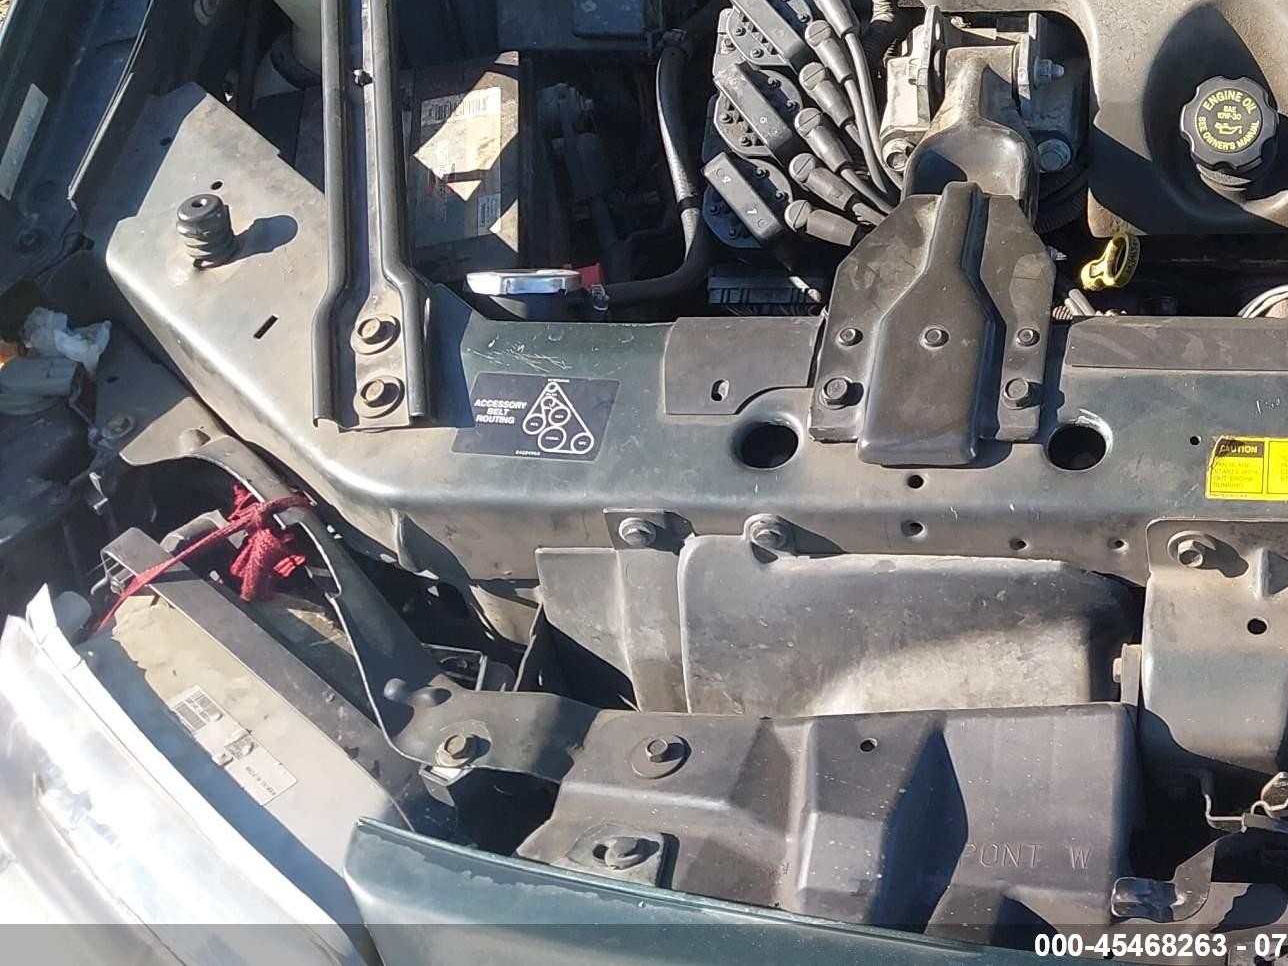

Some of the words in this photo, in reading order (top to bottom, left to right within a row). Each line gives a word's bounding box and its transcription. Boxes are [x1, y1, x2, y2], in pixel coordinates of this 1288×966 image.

[1203, 90, 1243, 111] ENGINE
[1242, 97, 1257, 115] OIL
[1236, 120, 1260, 148] MANUAL
[474, 399, 528, 410] ACCESSORY
[486, 408, 510, 416] BELT
[475, 415, 515, 424] ROUTING
[1219, 444, 1258, 453] CAUTION
[1070, 844, 1093, 870] W
